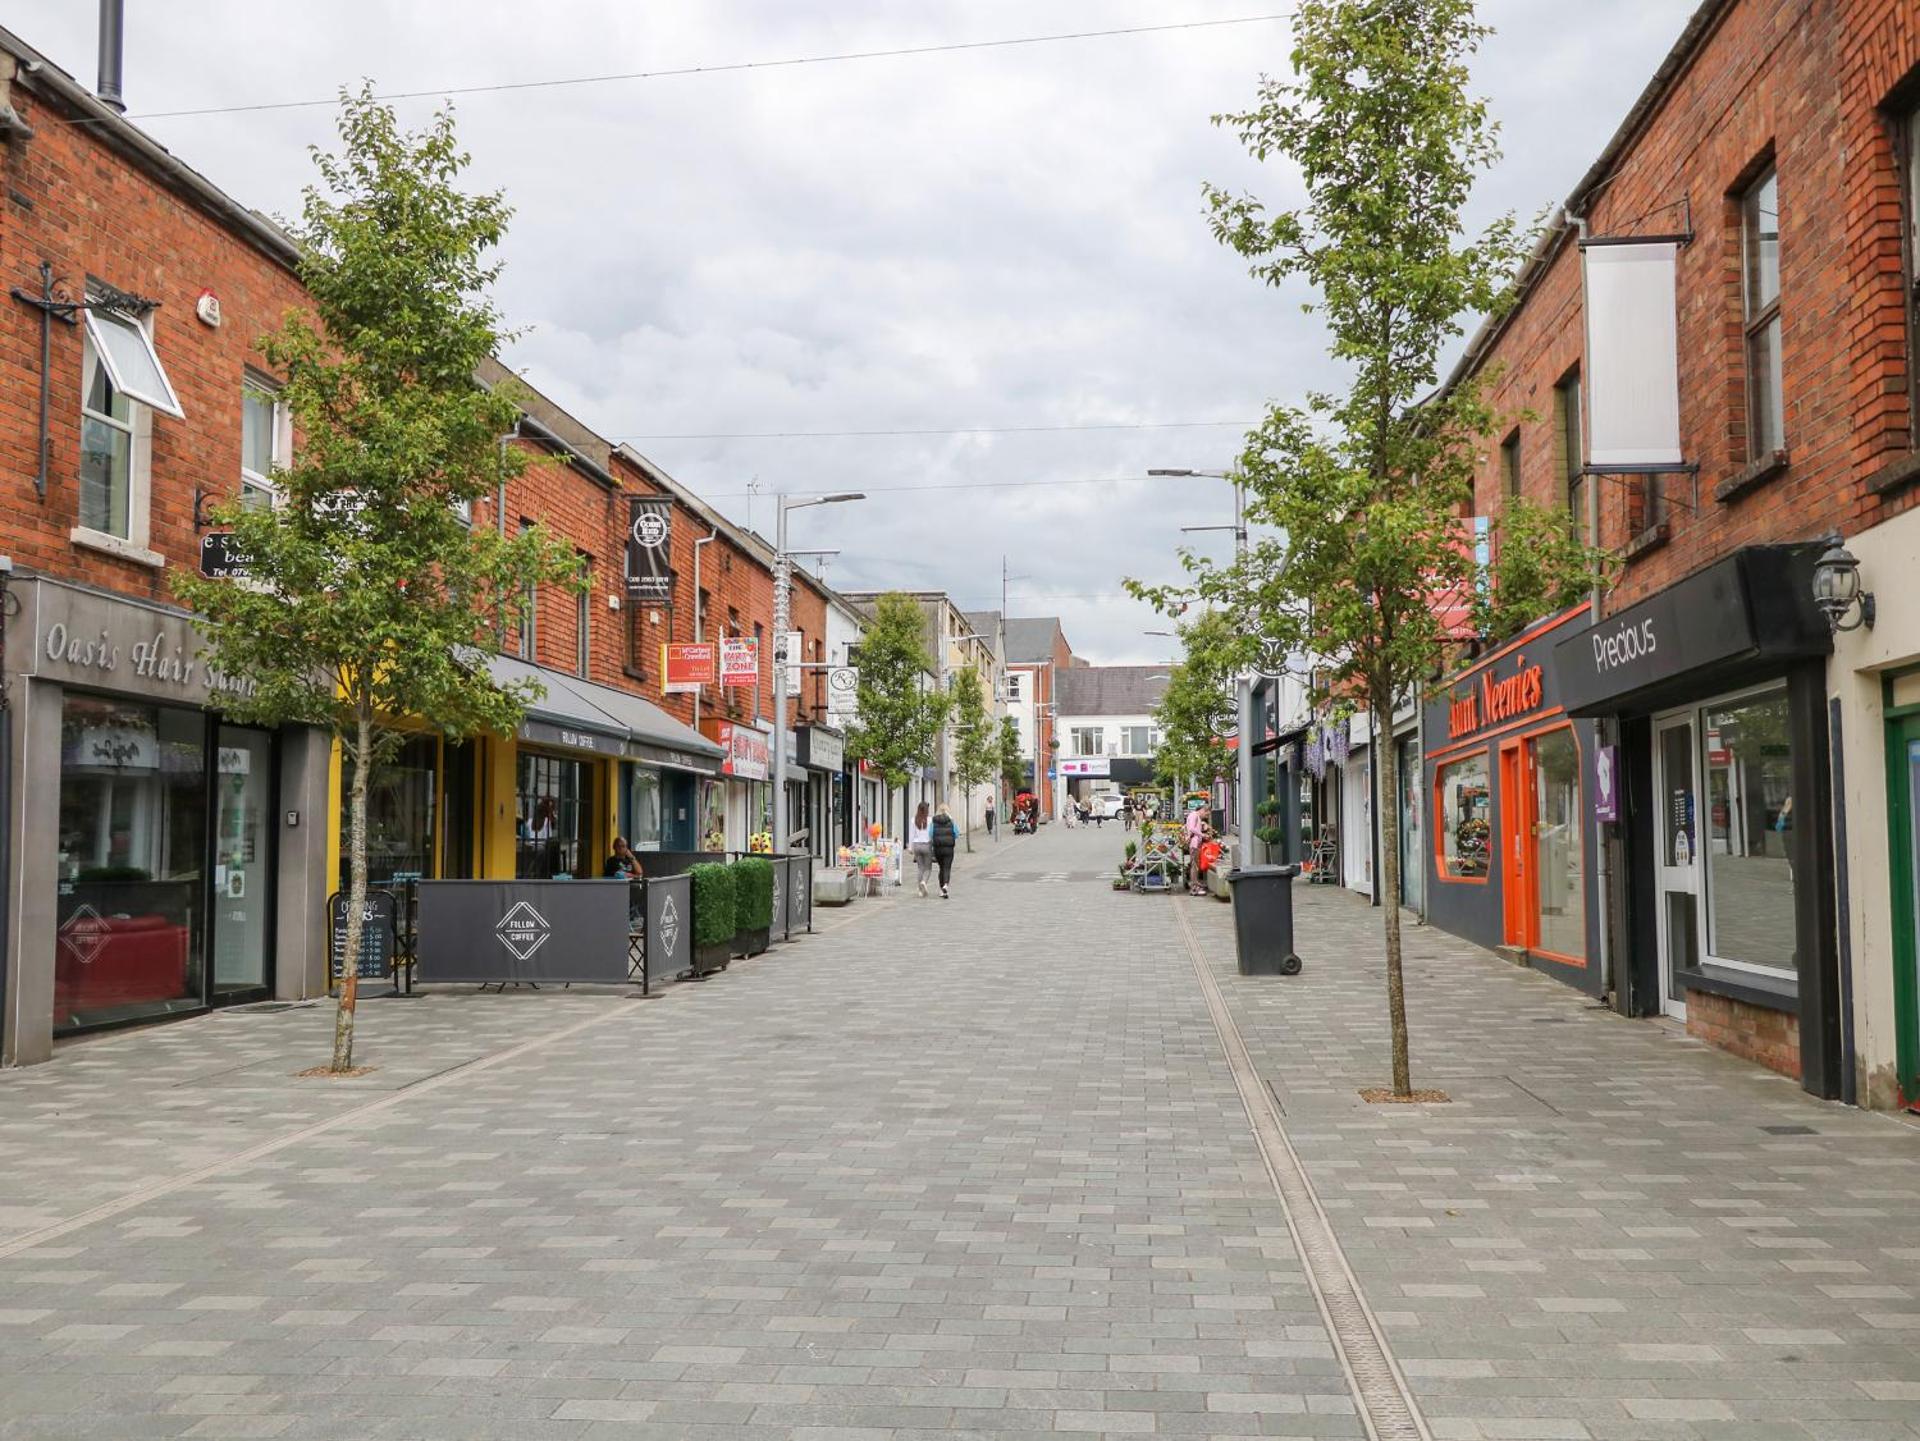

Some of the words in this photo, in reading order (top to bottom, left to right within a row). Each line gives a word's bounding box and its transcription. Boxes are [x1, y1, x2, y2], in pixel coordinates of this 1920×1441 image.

[212, 567, 228, 577] Tel
[1592, 618, 1656, 673] Precious
[47, 623, 119, 671] Oasis
[132, 632, 193, 685] Hair
[724, 652, 757, 662] PARTY
[726, 662, 754, 671] ZONE
[1449, 682, 1479, 739] Aunt
[510, 920, 536, 929] FOLLOW
[511, 933, 535, 941] COFFEE
